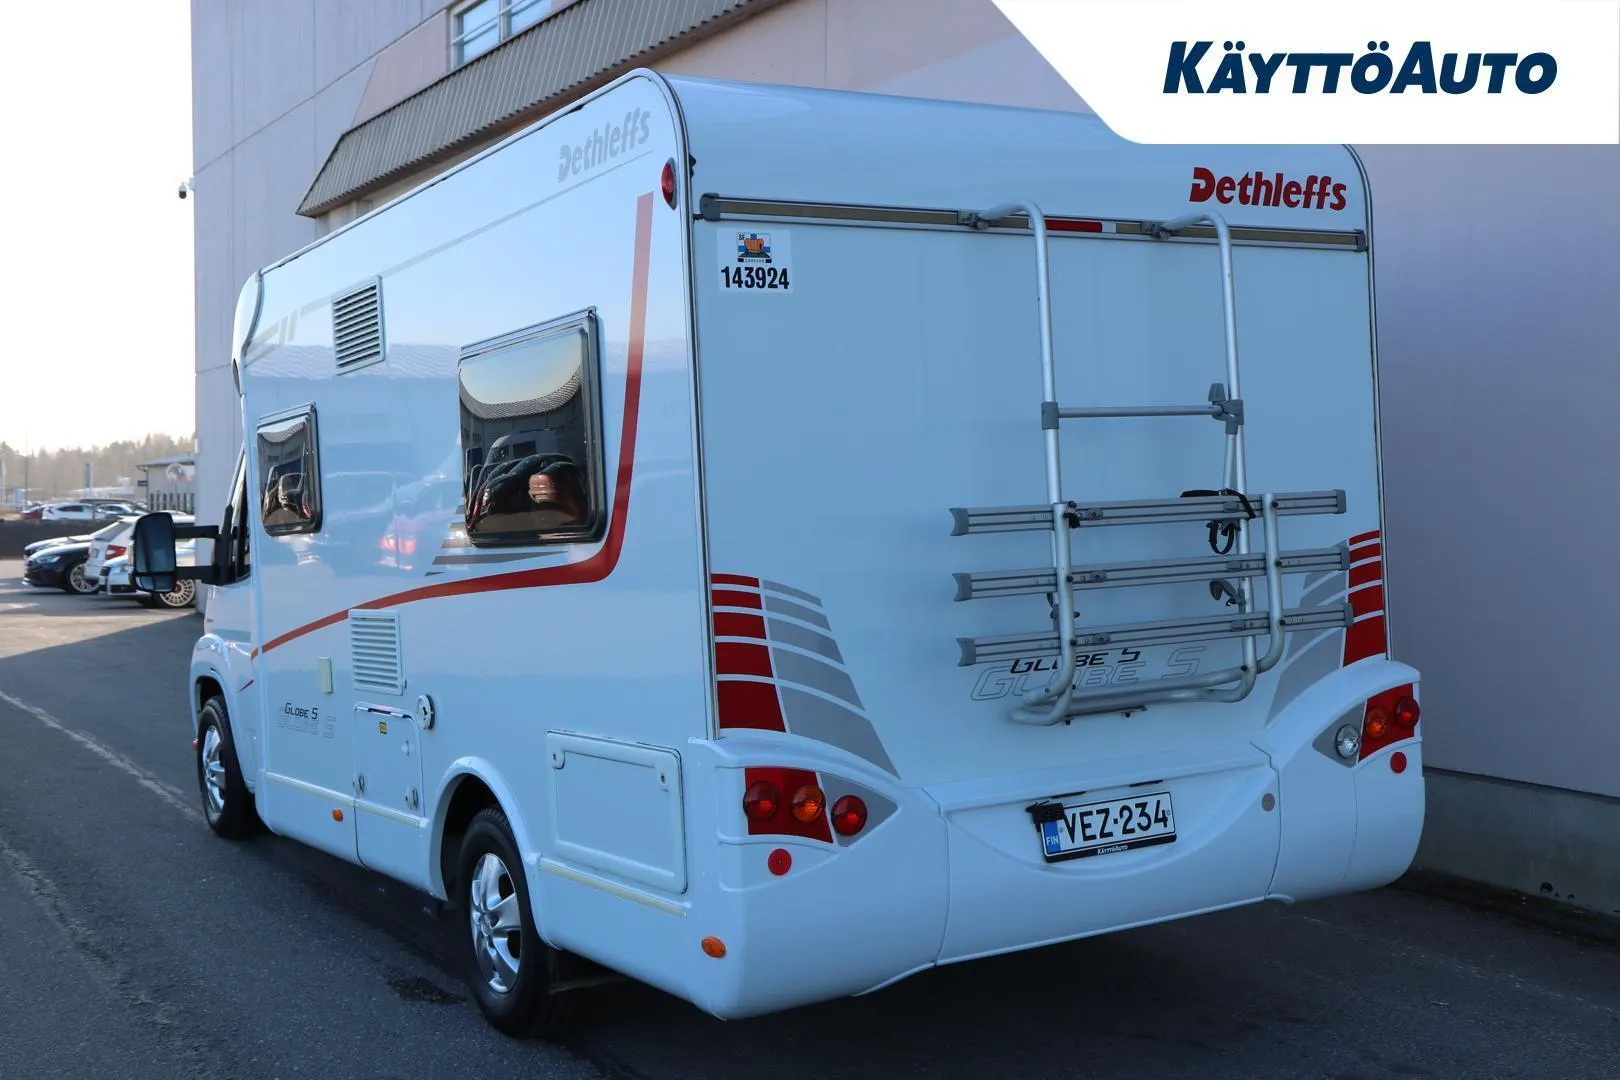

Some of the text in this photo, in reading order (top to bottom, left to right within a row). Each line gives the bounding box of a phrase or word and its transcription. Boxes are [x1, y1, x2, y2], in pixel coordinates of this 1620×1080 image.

[557, 106, 651, 183] Dethleffs
[1189, 166, 1347, 211] Dethleffs
[720, 265, 790, 290] 143924
[1117, 648, 1141, 663] S
[284, 702, 319, 720] GLOBE S
[1063, 799, 1169, 844] VEZ-234
[1045, 834, 1060, 846] FIN
